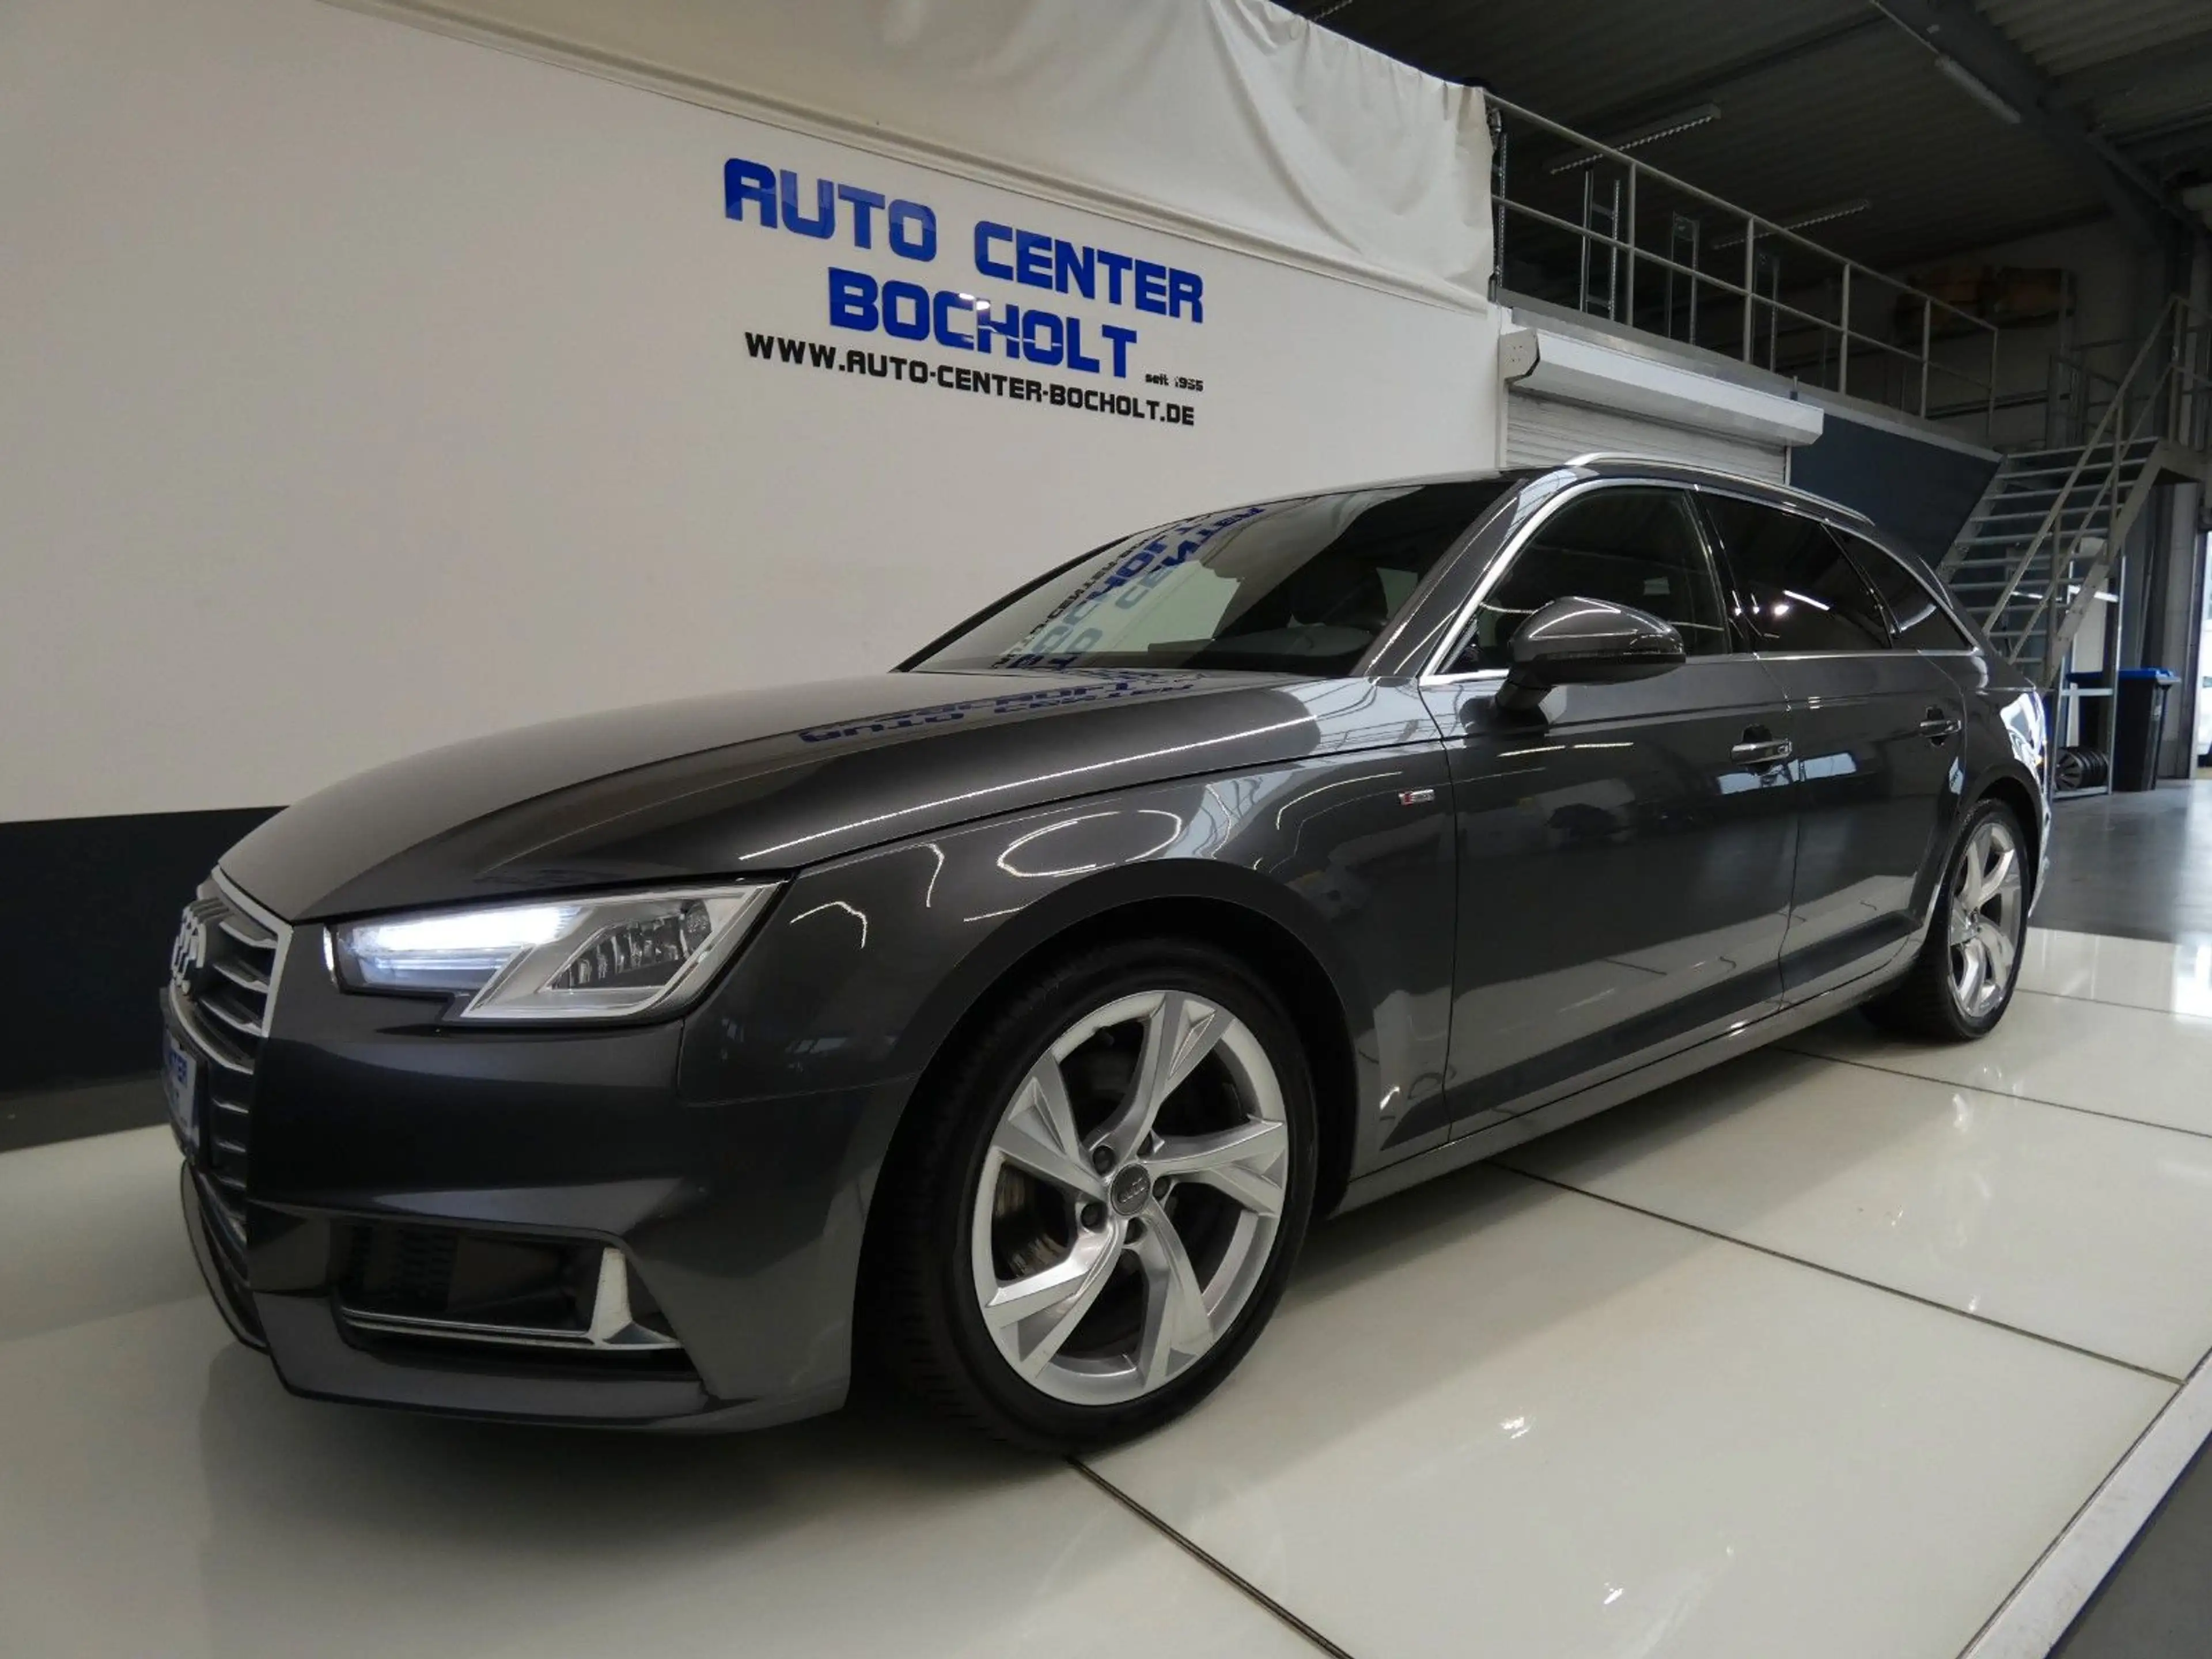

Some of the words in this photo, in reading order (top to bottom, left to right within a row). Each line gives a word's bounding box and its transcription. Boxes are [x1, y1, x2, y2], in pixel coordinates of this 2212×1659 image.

[724, 157, 938, 262] AUTO
[975, 221, 1203, 323] CENTER
[828, 267, 1138, 378] BOCHOLT
[744, 332, 1195, 426] WWW.AUTO-CENTER-BOCHOLT.DE
